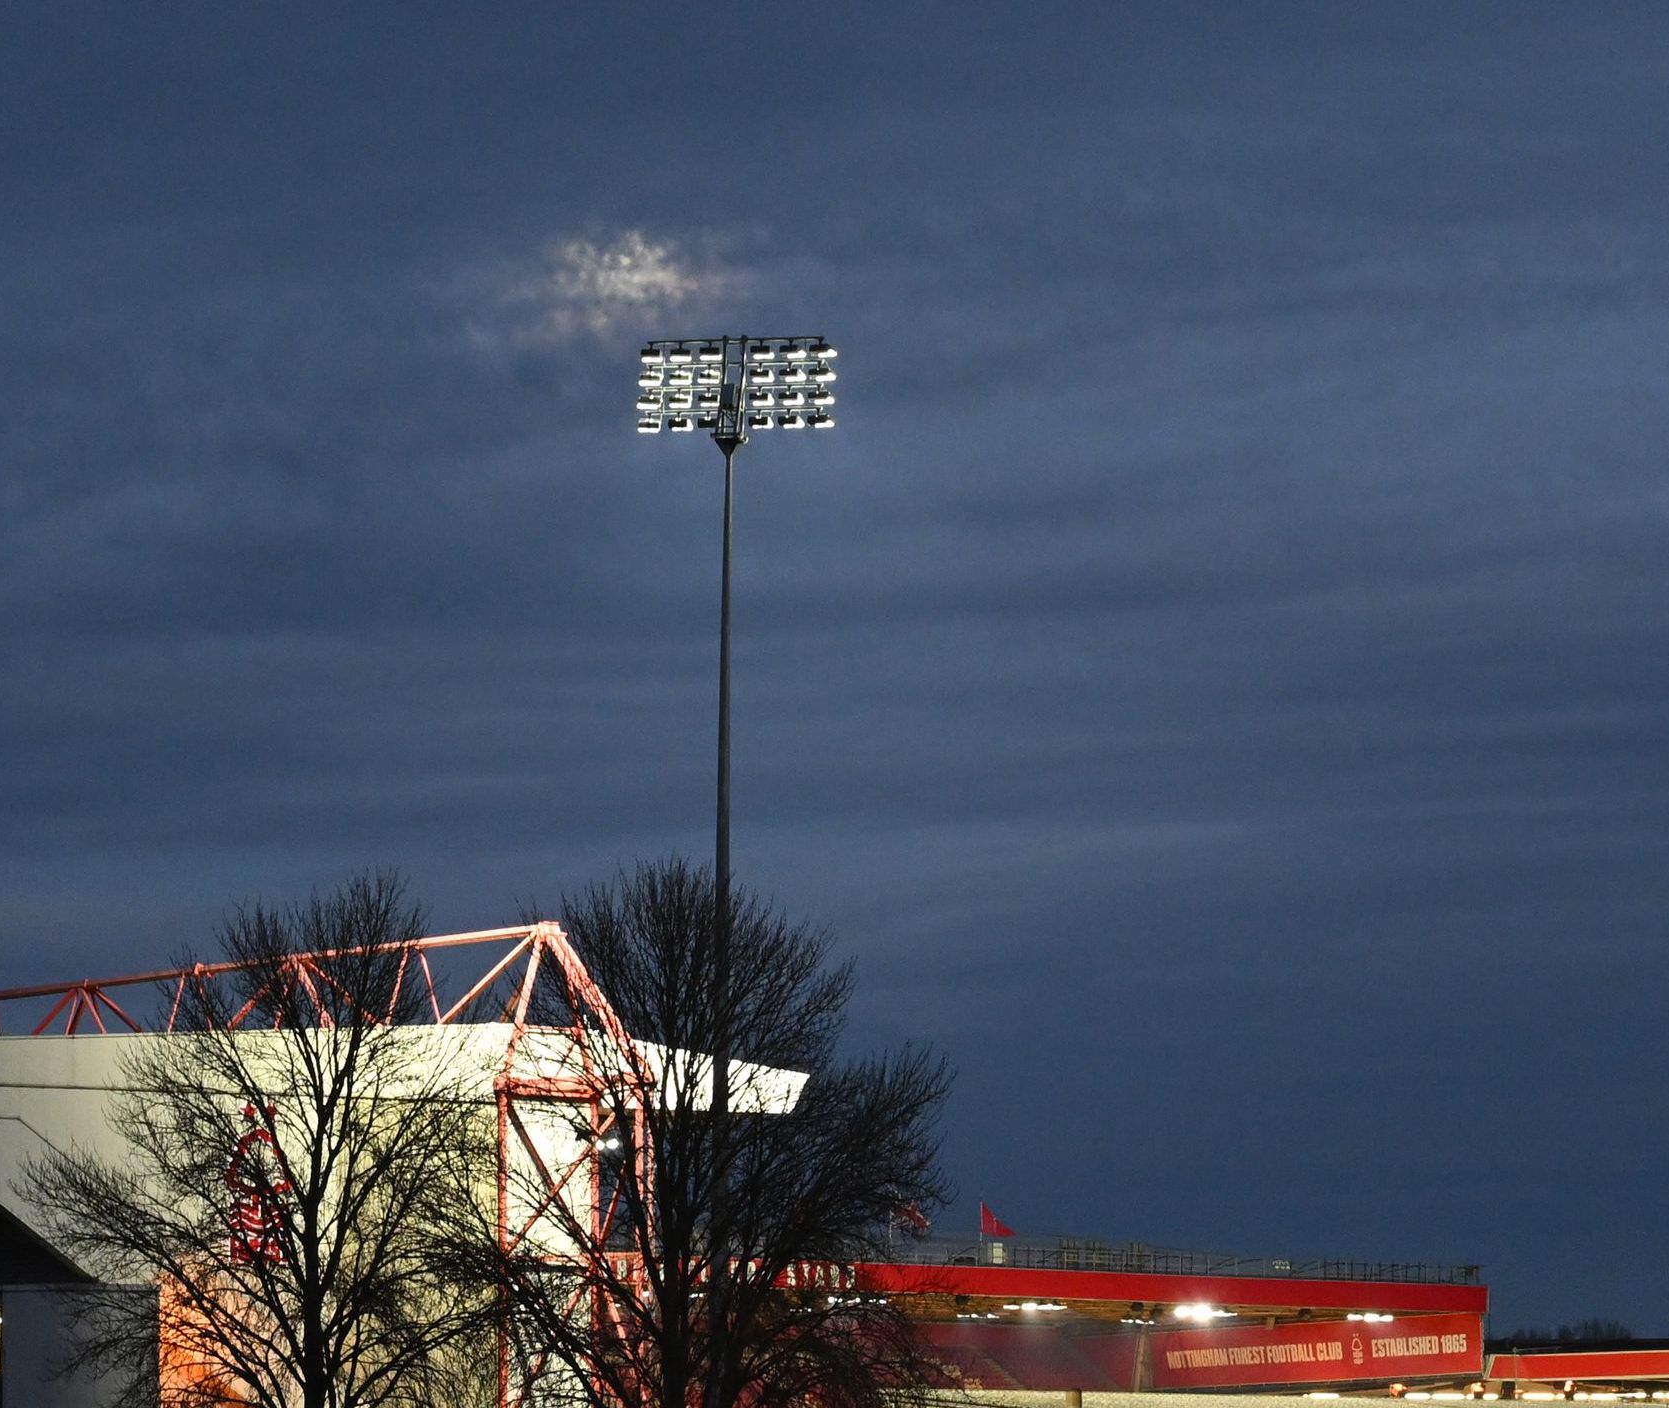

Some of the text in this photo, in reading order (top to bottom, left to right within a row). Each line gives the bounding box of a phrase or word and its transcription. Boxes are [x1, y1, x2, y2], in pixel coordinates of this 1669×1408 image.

[1166, 1342, 1343, 1369] NOTTINGHAM FOREST FOOTBALL CLUB
[1371, 1334, 1467, 1358] ESTABLISHED 1865
